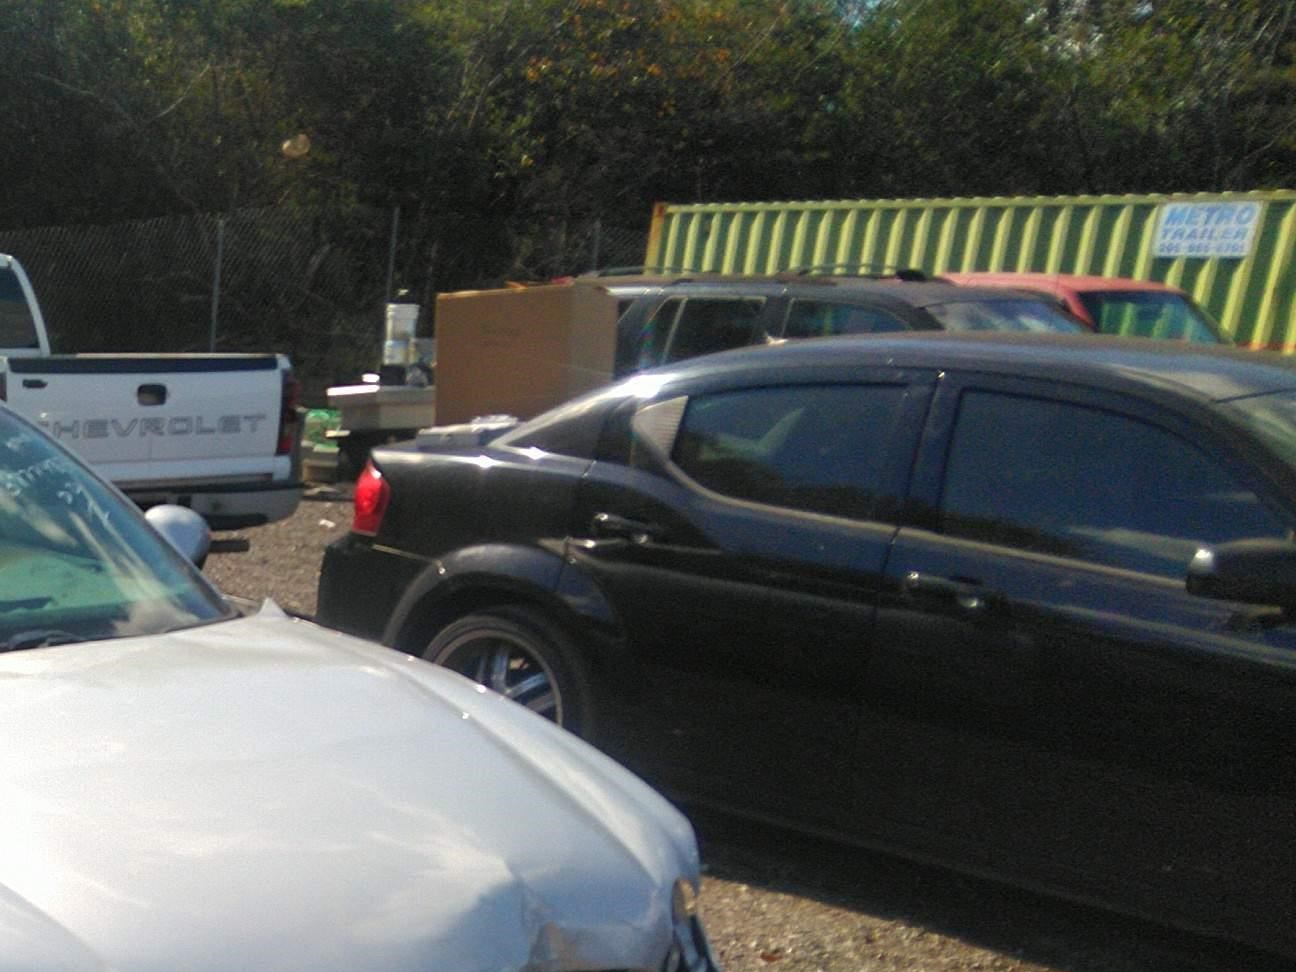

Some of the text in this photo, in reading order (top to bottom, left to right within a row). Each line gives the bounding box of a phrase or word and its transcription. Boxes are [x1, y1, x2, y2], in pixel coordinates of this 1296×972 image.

[1164, 206, 1256, 225] METRO
[1161, 227, 1249, 240] TRAILER
[37, 413, 266, 440] HEVROLET
